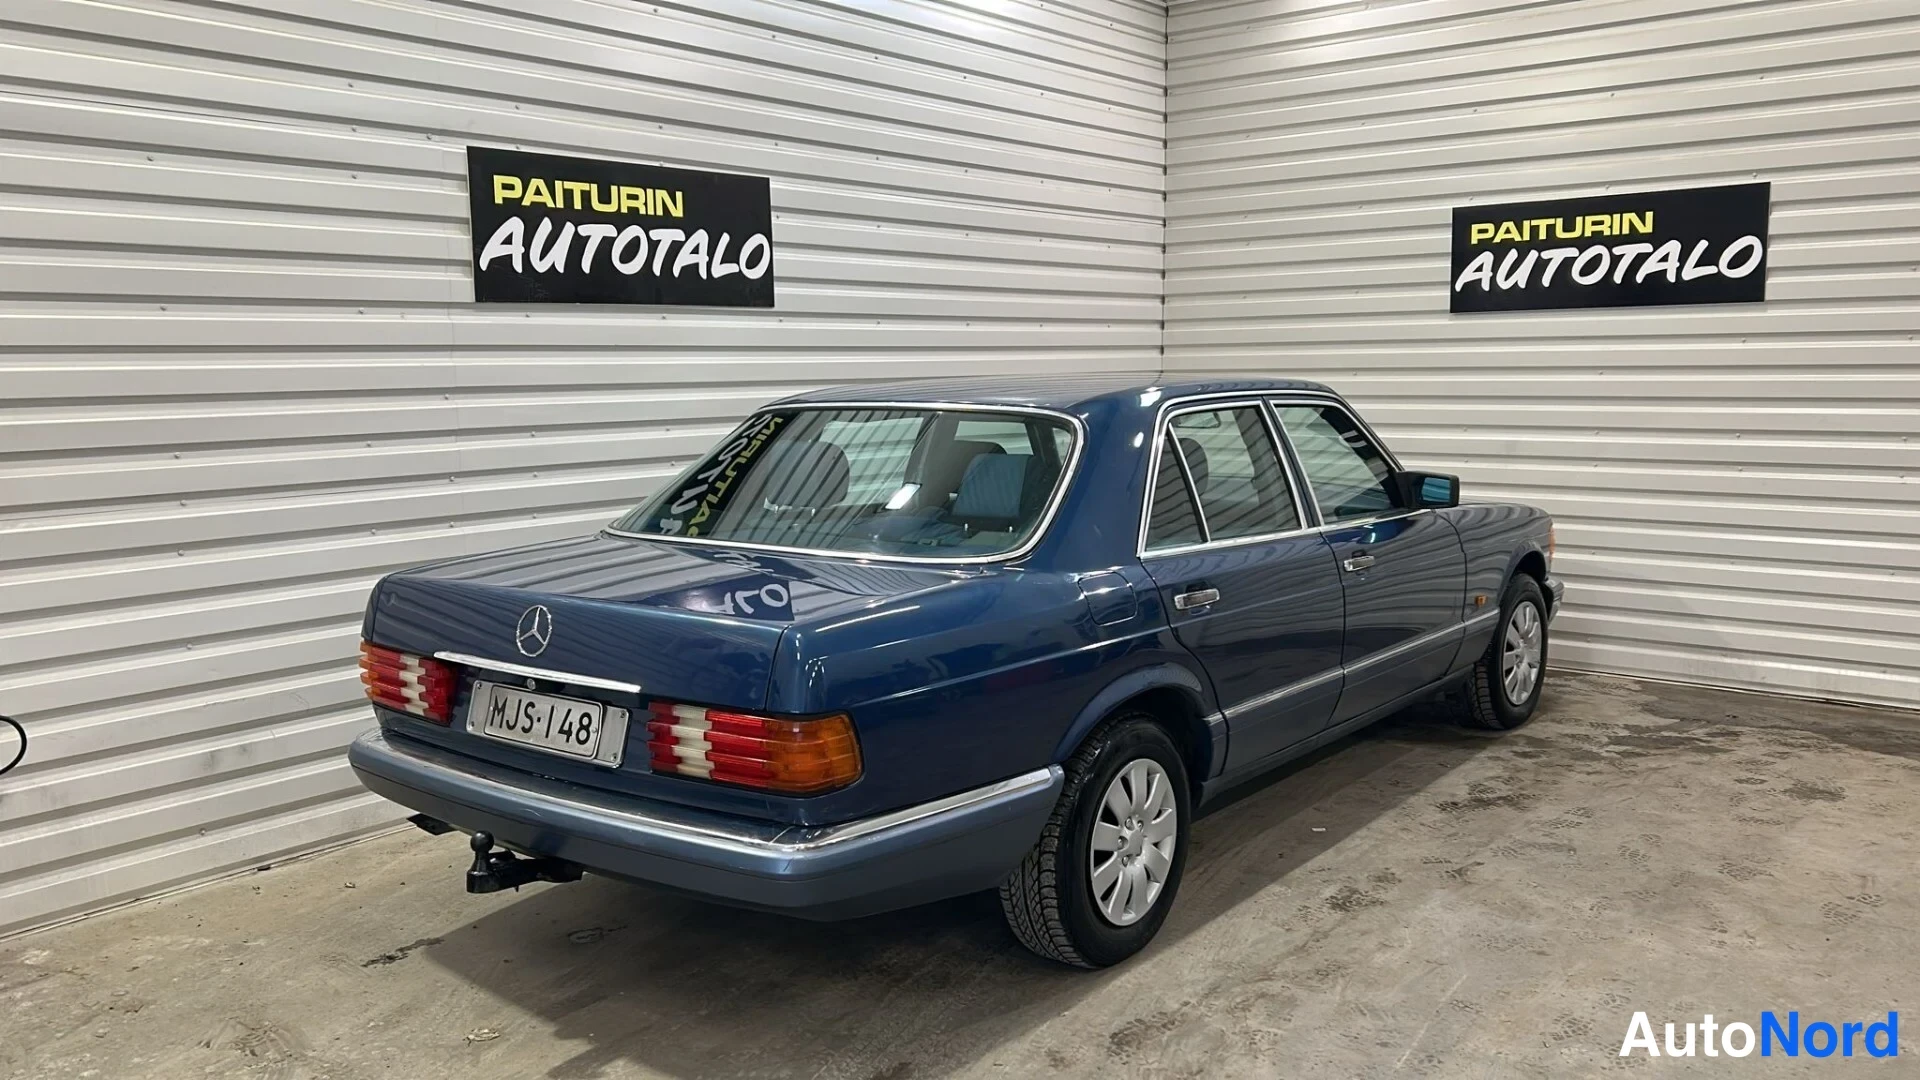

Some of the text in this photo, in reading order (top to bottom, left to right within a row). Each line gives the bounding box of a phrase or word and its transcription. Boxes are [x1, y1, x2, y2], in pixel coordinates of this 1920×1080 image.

[493, 175, 684, 218] PAITURIN
[479, 216, 771, 280] AUTOTALO
[1470, 211, 1654, 245] PAITURIN
[1454, 235, 1763, 293] AUTOTALO
